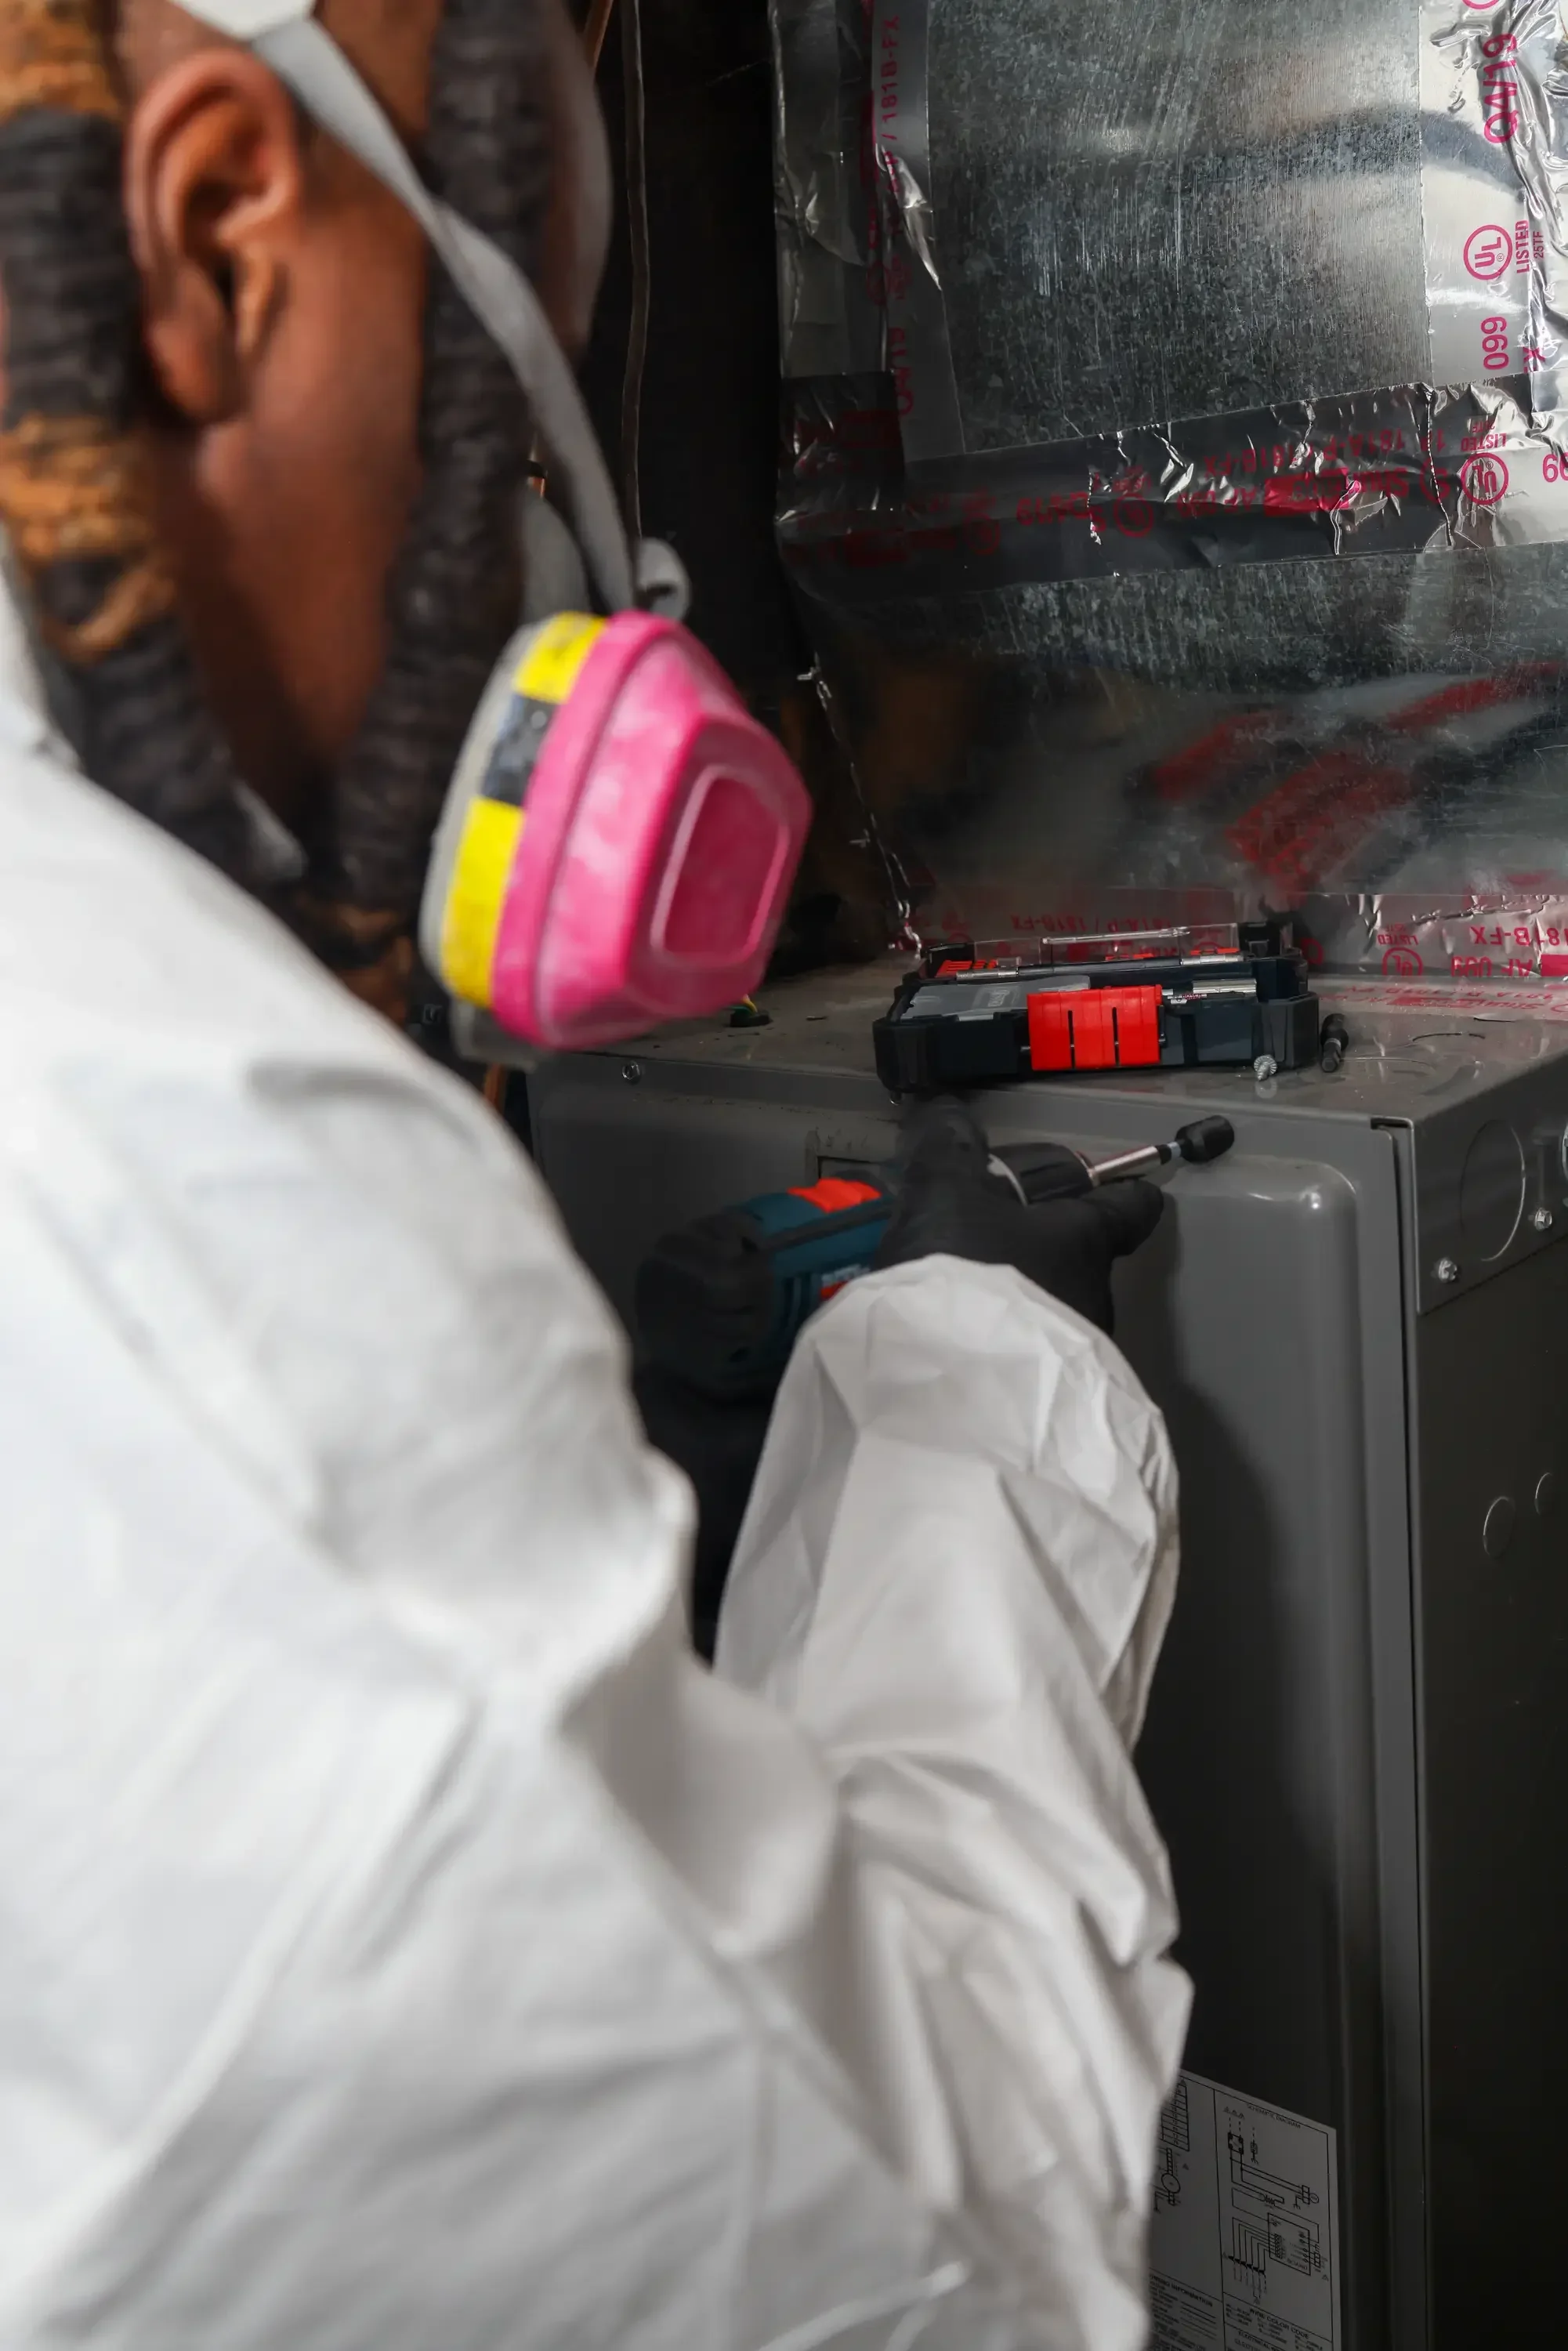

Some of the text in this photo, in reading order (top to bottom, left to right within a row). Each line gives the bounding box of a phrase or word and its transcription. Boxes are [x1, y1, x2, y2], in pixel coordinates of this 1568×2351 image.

[1483, 33, 1519, 143] Q4/19
[1474, 236, 1501, 269] UL
[1515, 219, 1530, 274] LISTED
[1533, 230, 1544, 259] 25TF
[1480, 316, 1509, 370] 099
[1461, 433, 1507, 453] LISTED
